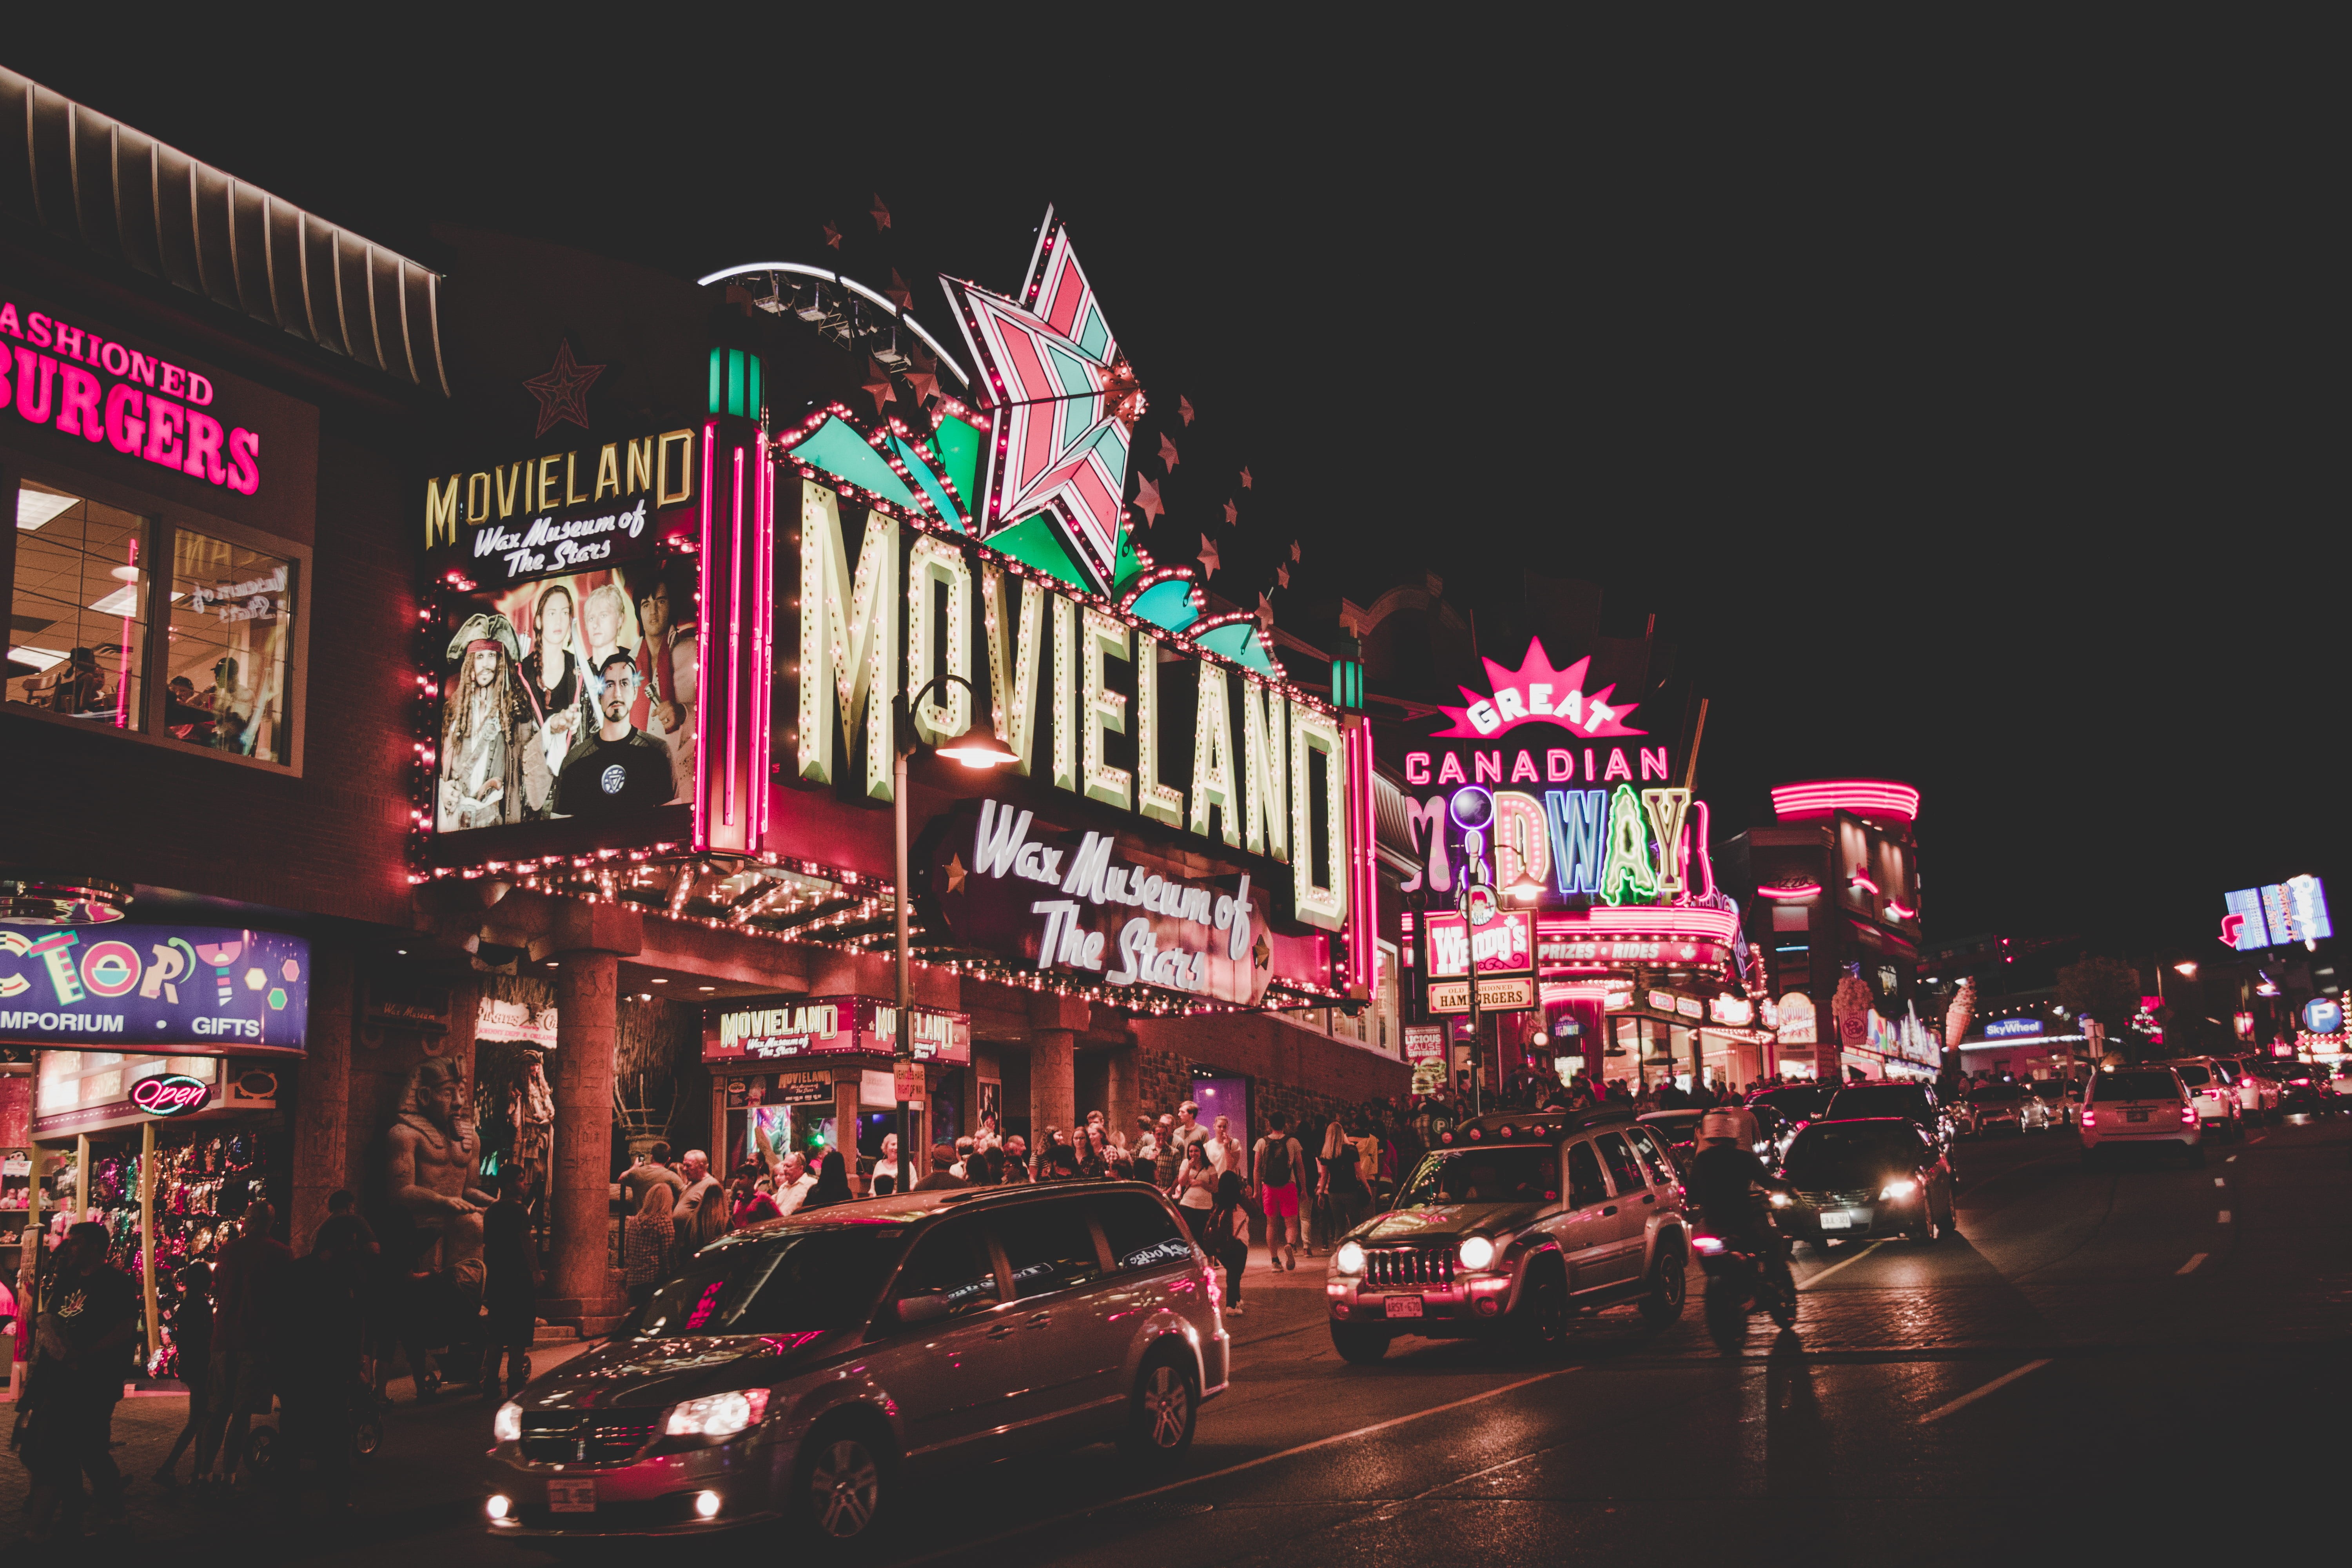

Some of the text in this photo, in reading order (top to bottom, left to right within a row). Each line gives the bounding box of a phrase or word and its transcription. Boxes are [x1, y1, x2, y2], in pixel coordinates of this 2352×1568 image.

[426, 429, 695, 550] MOVIELAND
[475, 499, 646, 557] Wax Museum of
[504, 539, 610, 577] The Stars
[799, 479, 1348, 932] MOVIELAND
[1466, 683, 1615, 735] GREAT
[1406, 747, 1668, 784] CANADIAN
[974, 799, 1252, 961] Wax Museum of
[1031, 900, 1205, 991] The Stars
[1538, 943, 1659, 959] PRIZES RIDES
[1440, 991, 1523, 1007] HAMURGERS
[0, 1011, 260, 1037] MPORIUM GIFTS
[403, 1005, 436, 1021] Museum
[720, 1004, 838, 1048] MOVIELAND
[2311, 1003, 2334, 1027] P
[875, 1006, 953, 1050] MOLAND
[1779, 1019, 1814, 1034] POPCORN
[1986, 1021, 2039, 1036] SkyWheel
[747, 1034, 809, 1050] Wax Museum of
[758, 1046, 798, 1059] The Stars
[779, 1070, 831, 1089] MOVIELAND
[898, 1084, 909, 1094] RIGHT
[910, 1084, 915, 1094] OF
[915, 1071, 924, 1081] HAVE
[133, 1080, 208, 1109] Open
